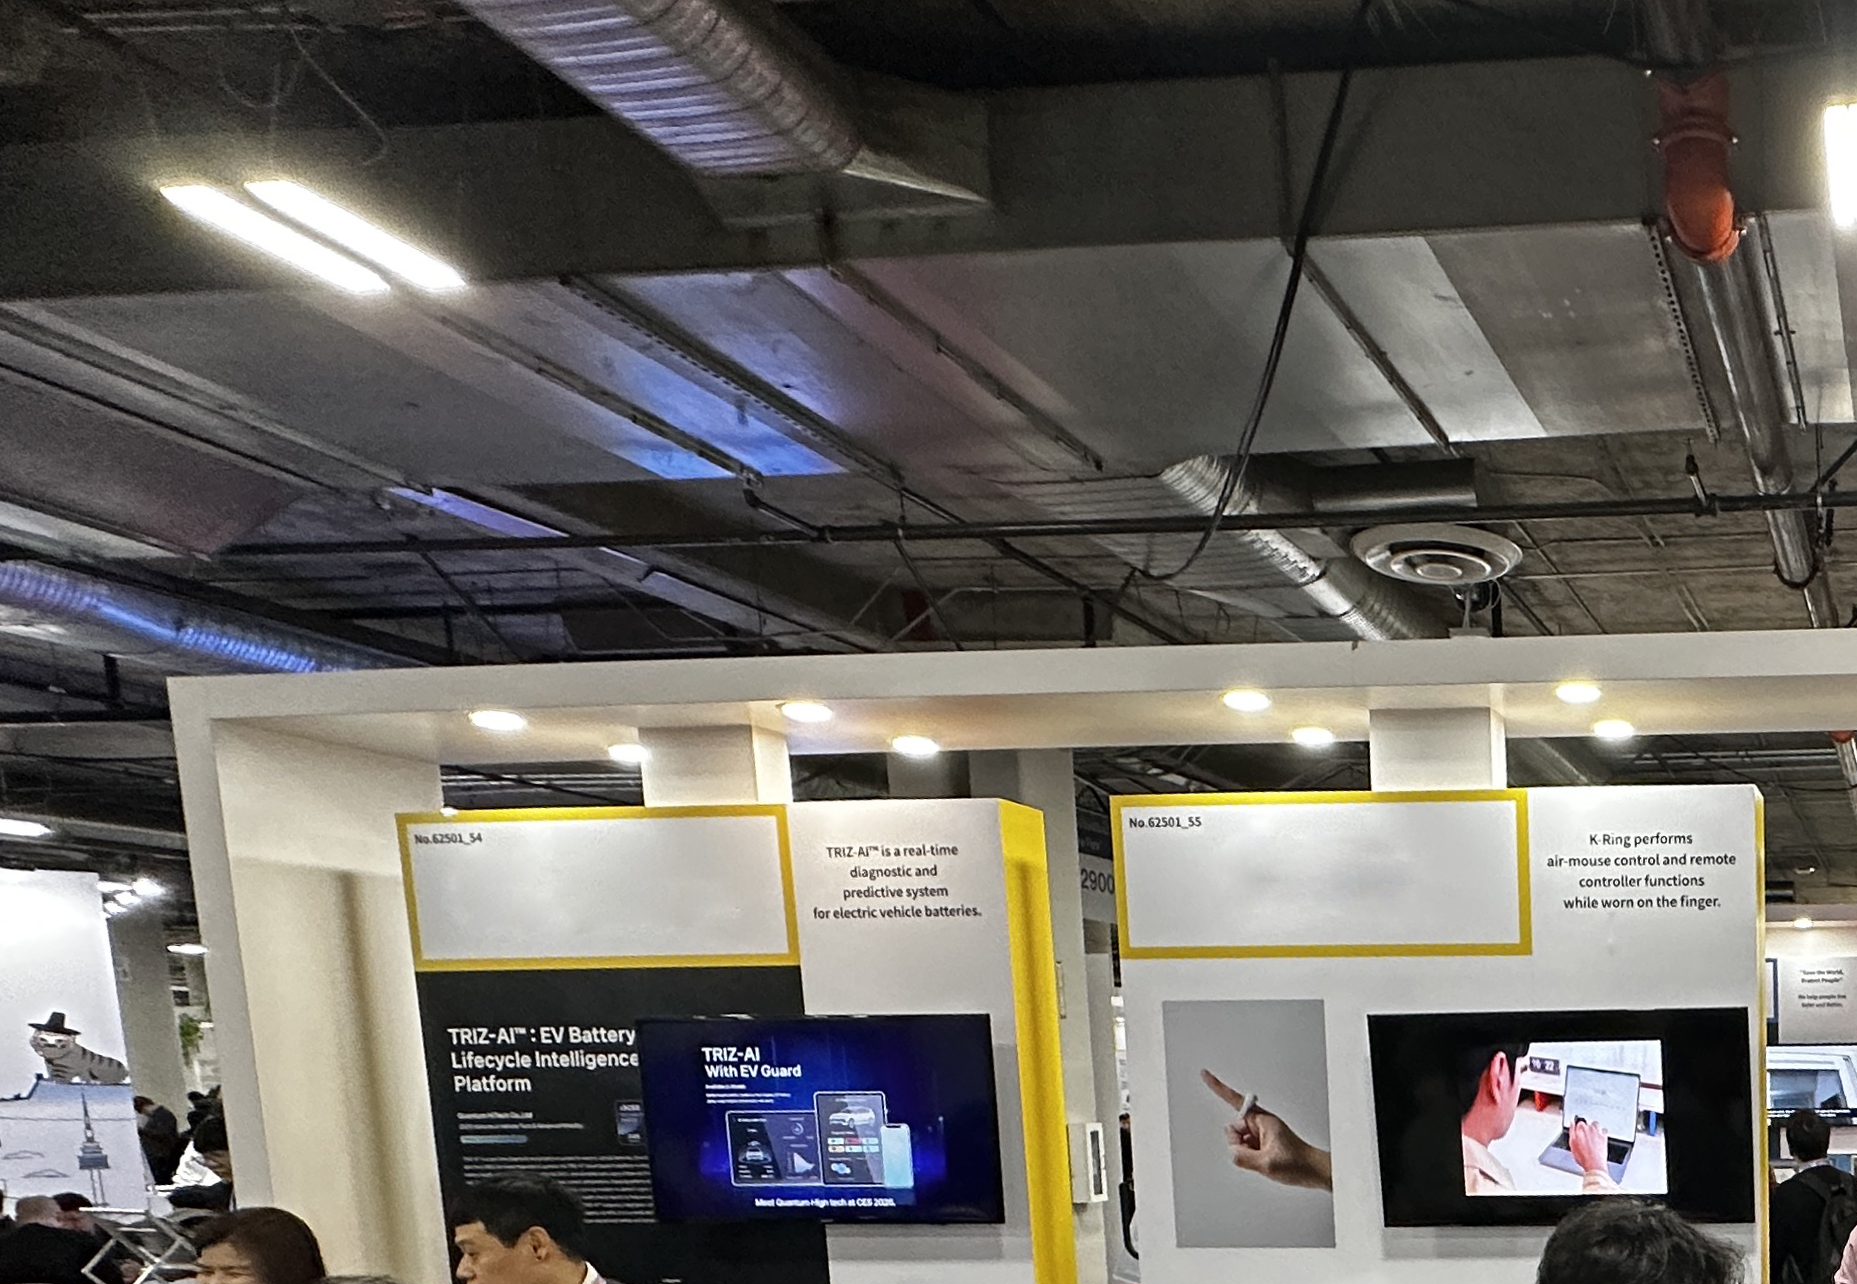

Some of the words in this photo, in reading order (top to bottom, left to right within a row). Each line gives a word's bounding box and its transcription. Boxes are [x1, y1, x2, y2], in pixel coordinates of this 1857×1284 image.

[1129, 816, 1202, 829] No.62501_55
[414, 832, 483, 846] No.62501_54
[1589, 833, 1631, 848] K-Ring
[1634, 832, 1693, 848] performs
[881, 845, 892, 857] is
[893, 847, 901, 857] a
[903, 844, 959, 857] real-time
[1547, 854, 1611, 867] air-mouse
[1614, 853, 1660, 866] control
[1662, 854, 1687, 866] and
[1690, 854, 1737, 865] remote
[849, 865, 912, 881] diagnostic
[914, 864, 938, 877] and
[1579, 875, 1642, 888] controller
[1644, 874, 1705, 887] functions
[842, 886, 904, 901] predictive
[905, 886, 949, 900] system
[1563, 896, 1599, 909] while
[1601, 898, 1634, 908] worn
[1637, 898, 1654, 908] on
[1656, 895, 1678, 908] the
[1680, 895, 1722, 911] finger.
[813, 907, 830, 919] for
[833, 906, 878, 919] electric
[879, 905, 922, 918] vehicle
[924, 904, 982, 917] batteries.
[540, 1027, 564, 1044] EV
[568, 1026, 636, 1046] Battery
[451, 1051, 532, 1071] Lifecycle
[535, 1050, 640, 1070] Intelligence
[701, 1046, 760, 1062] TRIZ-AI
[704, 1064, 738, 1078] With
[740, 1065, 758, 1078] EV
[760, 1064, 801, 1078] Guard
[453, 1075, 532, 1092] Platform
